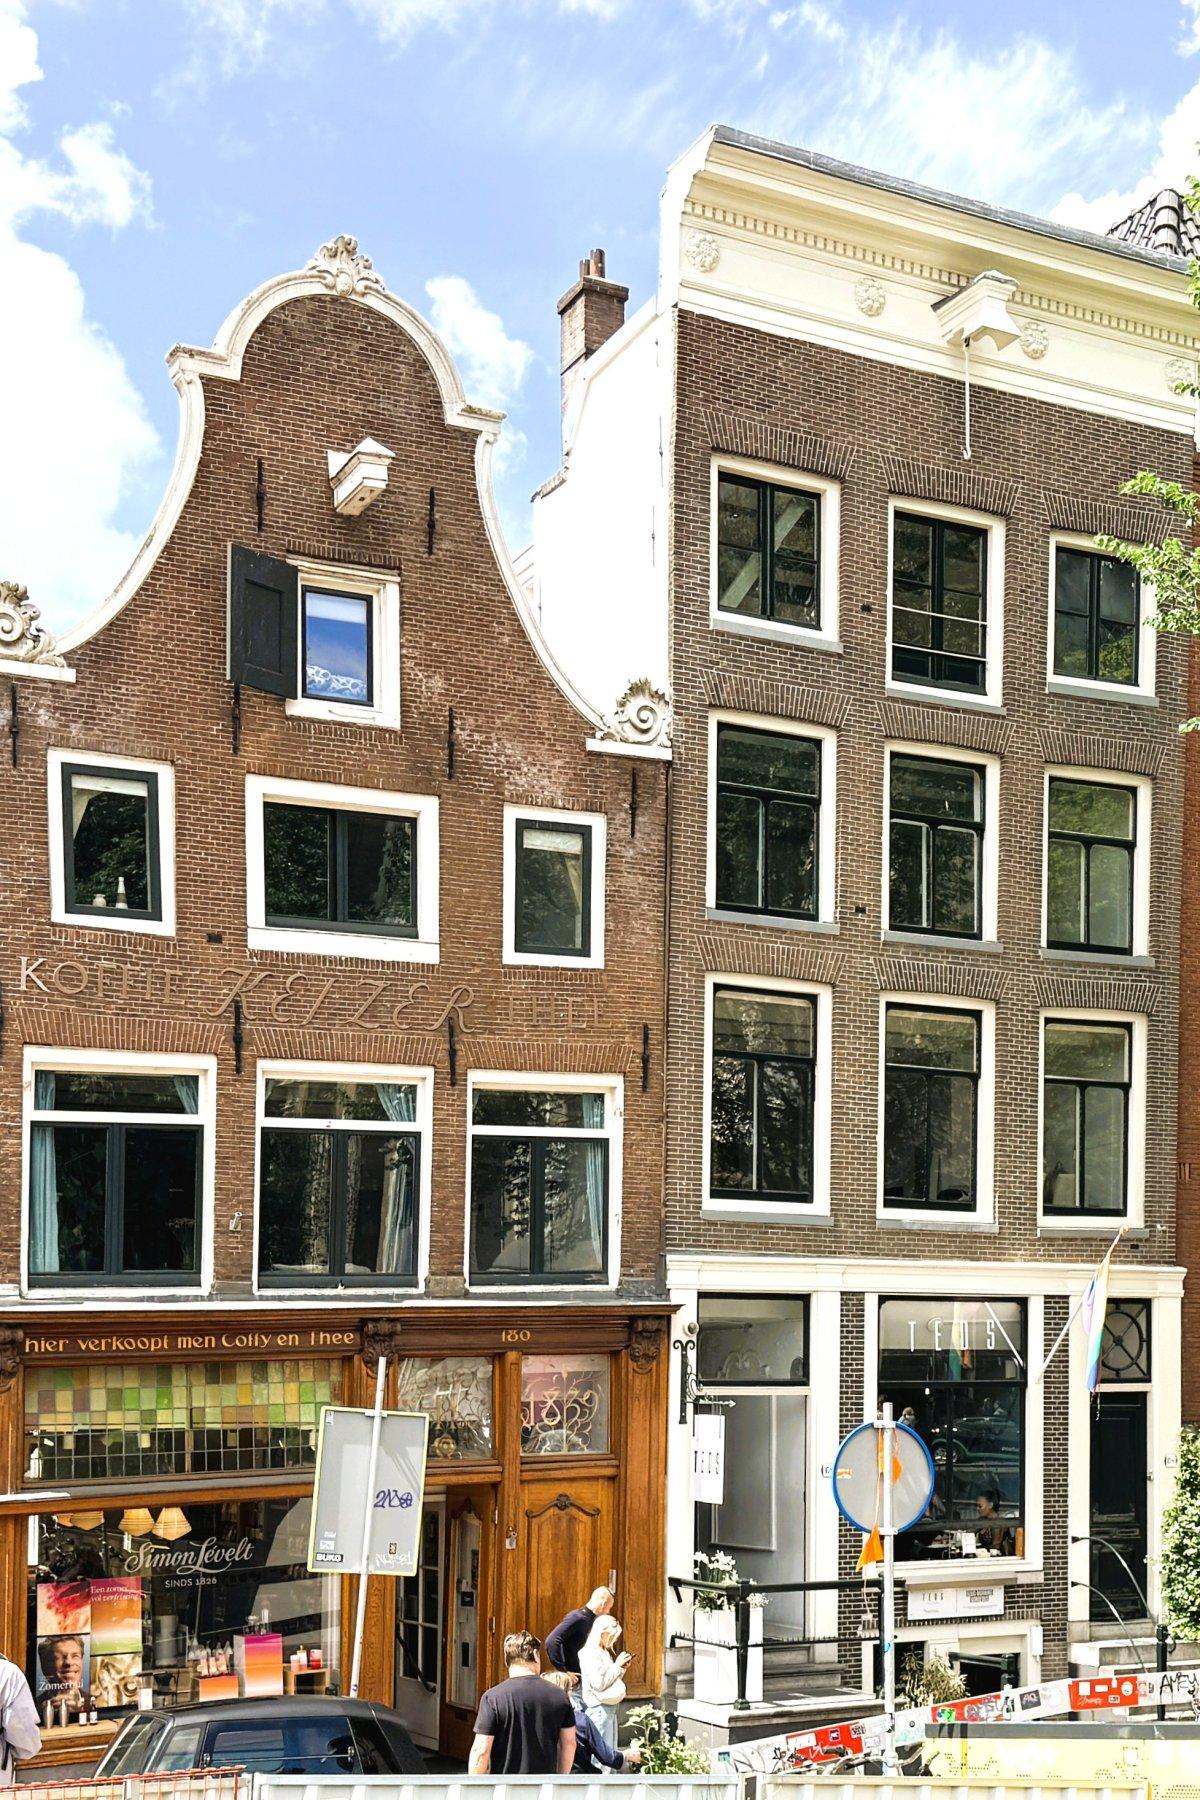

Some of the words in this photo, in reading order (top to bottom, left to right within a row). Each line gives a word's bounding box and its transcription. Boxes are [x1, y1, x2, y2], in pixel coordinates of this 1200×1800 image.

[19, 956, 186, 1004] KOFFIE
[24, 1337, 69, 1353] hier
[77, 1335, 169, 1352] verkoopt
[177, 1336, 216, 1349] men
[276, 1333, 299, 1347] en
[309, 1331, 355, 1346] Thee
[500, 1329, 531, 1343] 180
[908, 1319, 995, 1352] TEDS
[124, 1541, 197, 1573] Simon
[176, 1536, 254, 1575] Lévelt
[315, 1552, 342, 1563] BUKO
[165, 1578, 193, 1588] SINDS
[195, 1576, 217, 1586] 1826
